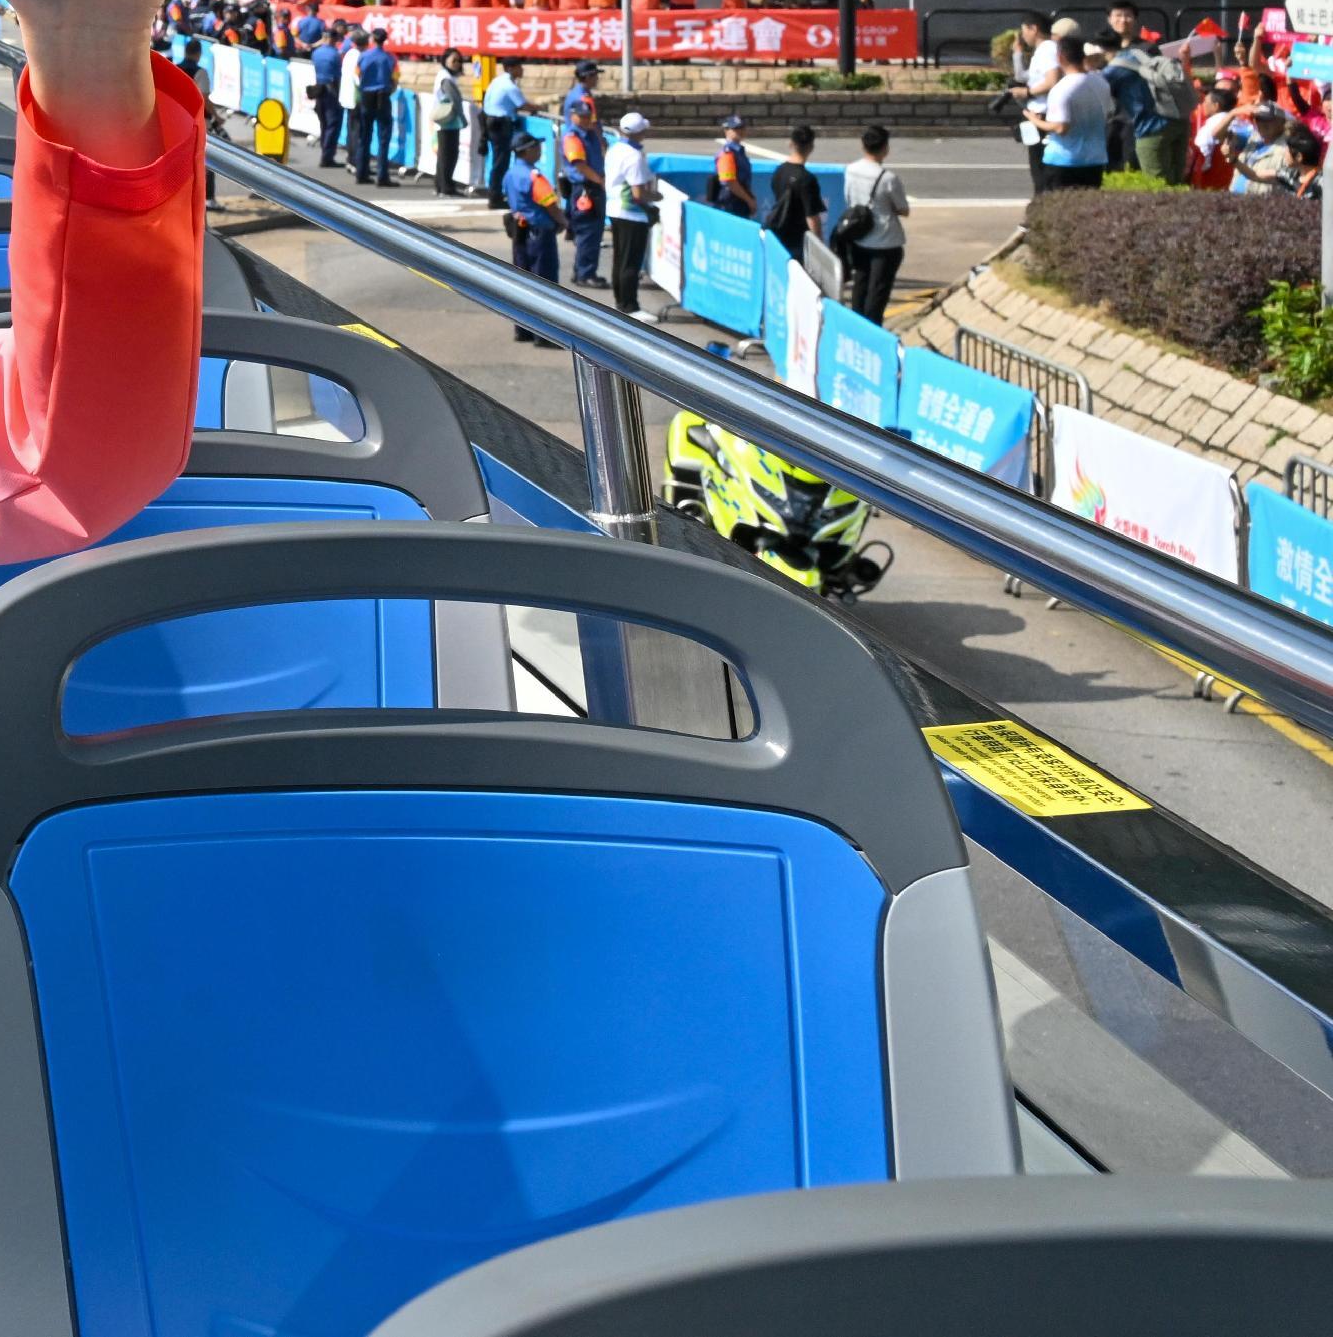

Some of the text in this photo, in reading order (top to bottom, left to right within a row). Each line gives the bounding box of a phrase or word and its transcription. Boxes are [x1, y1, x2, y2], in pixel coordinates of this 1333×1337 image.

[361, 14, 786, 52] 信和集團 全力支持 十五運會
